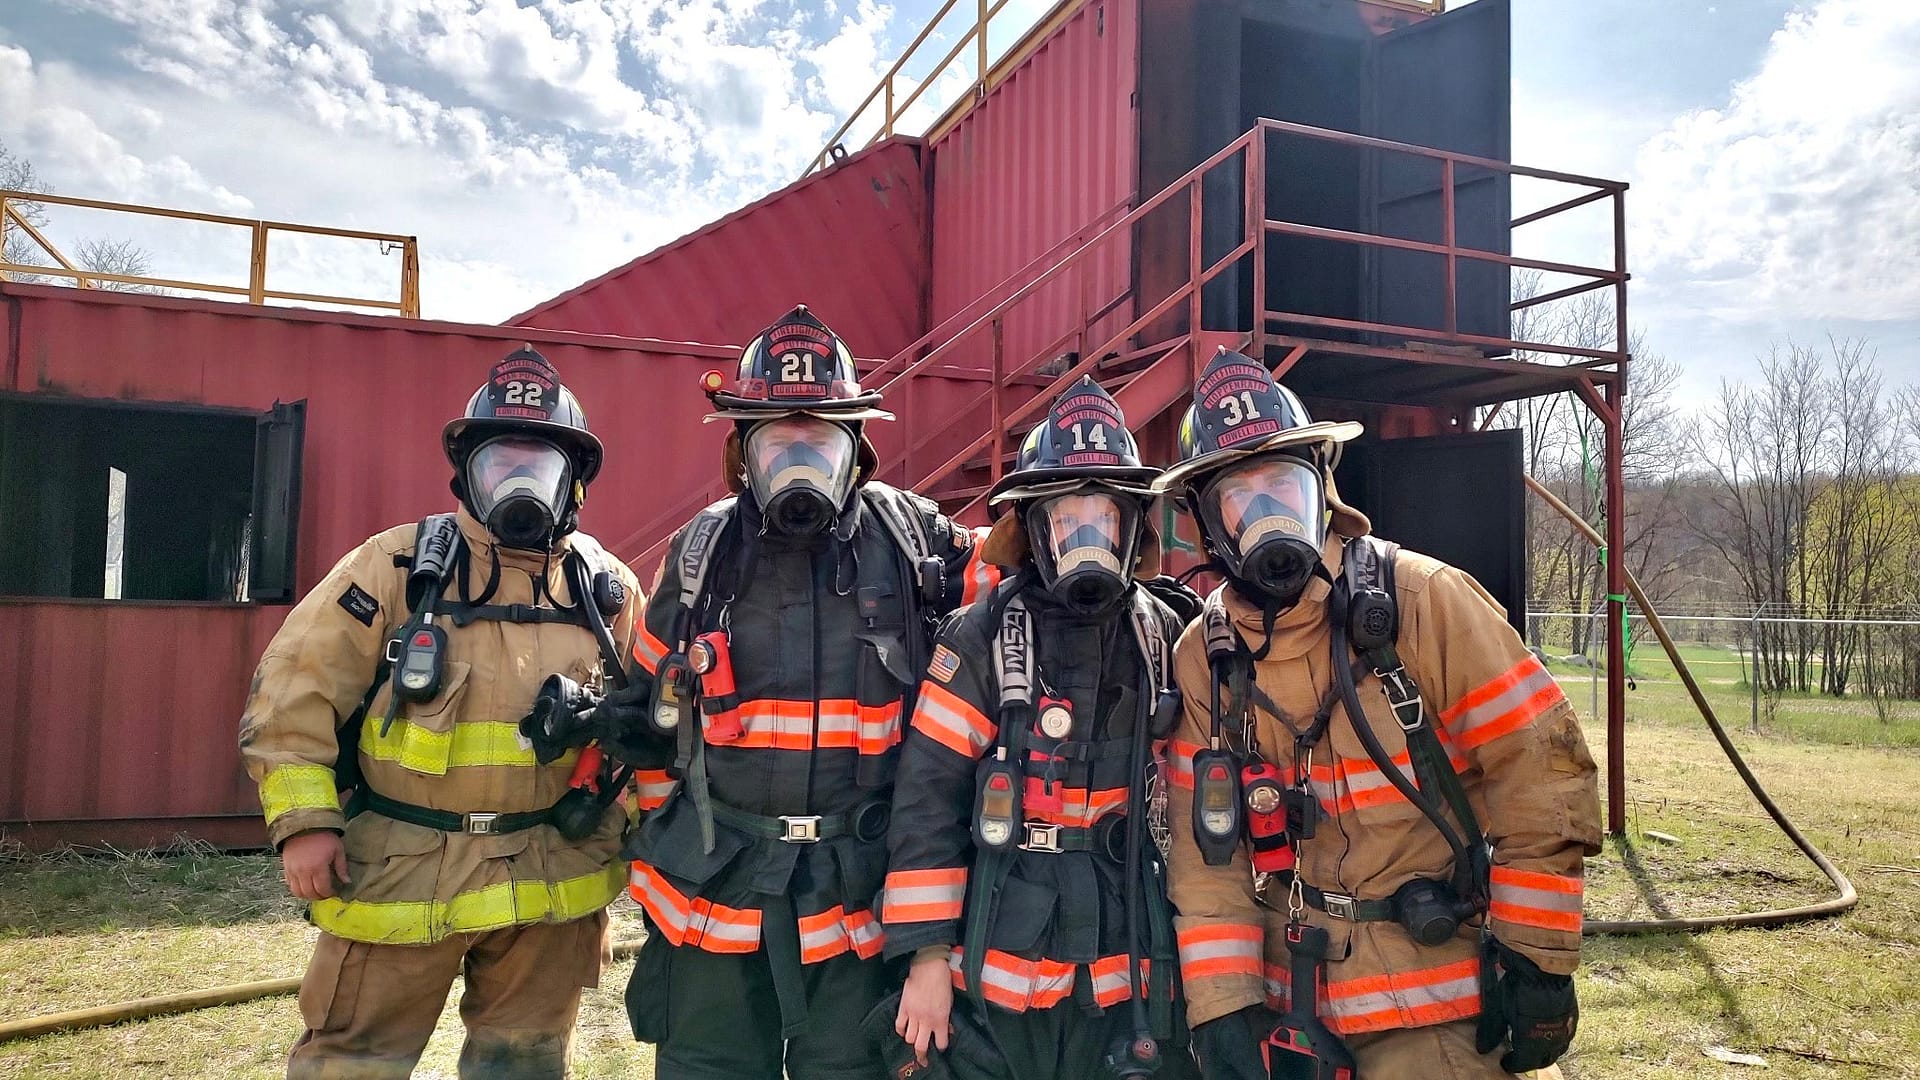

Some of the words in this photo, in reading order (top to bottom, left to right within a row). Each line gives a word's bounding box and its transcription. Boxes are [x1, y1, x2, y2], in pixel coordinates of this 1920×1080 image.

[774, 325, 825, 340] FIREFIGHTER
[782, 353, 816, 382] 21
[1204, 364, 1260, 387] FIREFIGHTER
[505, 381, 543, 407] 22
[1061, 395, 1115, 413] FIREFIGHTER
[1207, 380, 1265, 406] HOPPENRATH
[1070, 411, 1107, 422] HERRON
[1219, 391, 1260, 426] 31
[1071, 423, 1107, 451] 14
[1221, 427, 1253, 444] LOWELL
[1254, 421, 1276, 434] AREA
[1066, 454, 1097, 465] LOWELL
[1098, 454, 1118, 465] AREA
[428, 518, 457, 554] MSA
[684, 518, 718, 576] MSA
[1003, 610, 1024, 671] MSA
